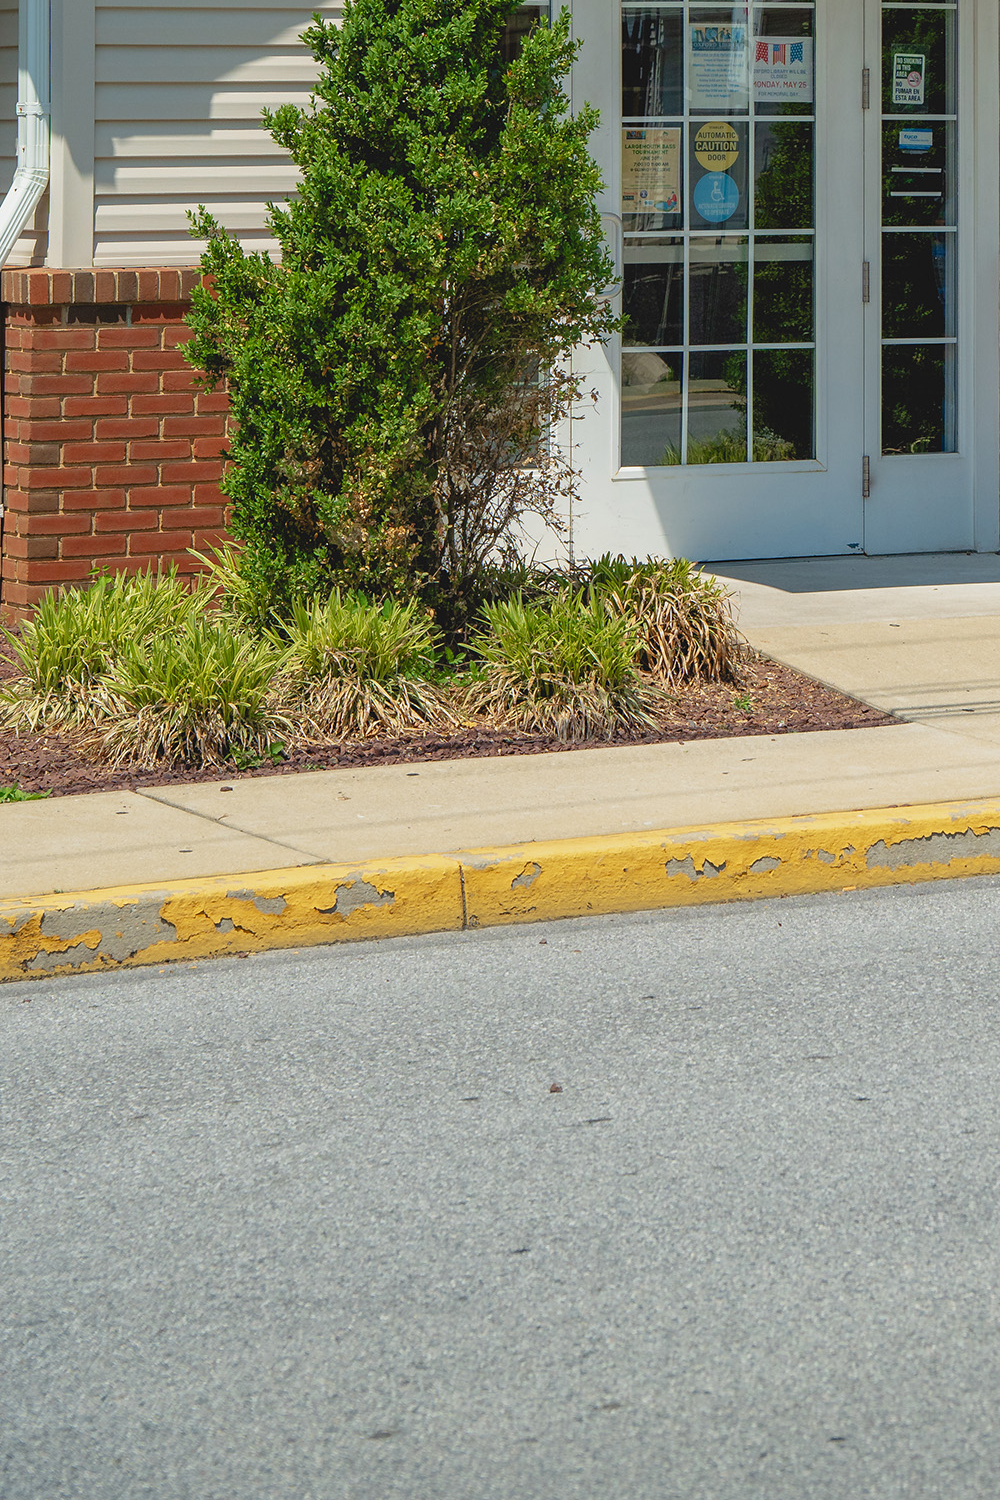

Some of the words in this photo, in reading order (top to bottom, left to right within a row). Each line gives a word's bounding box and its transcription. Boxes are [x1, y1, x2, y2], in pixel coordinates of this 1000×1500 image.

[782, 81, 797, 89] MAY
[698, 131, 736, 139] AUTOMATIC
[695, 141, 737, 151] CAUTION
[707, 153, 727, 161] DOOR
